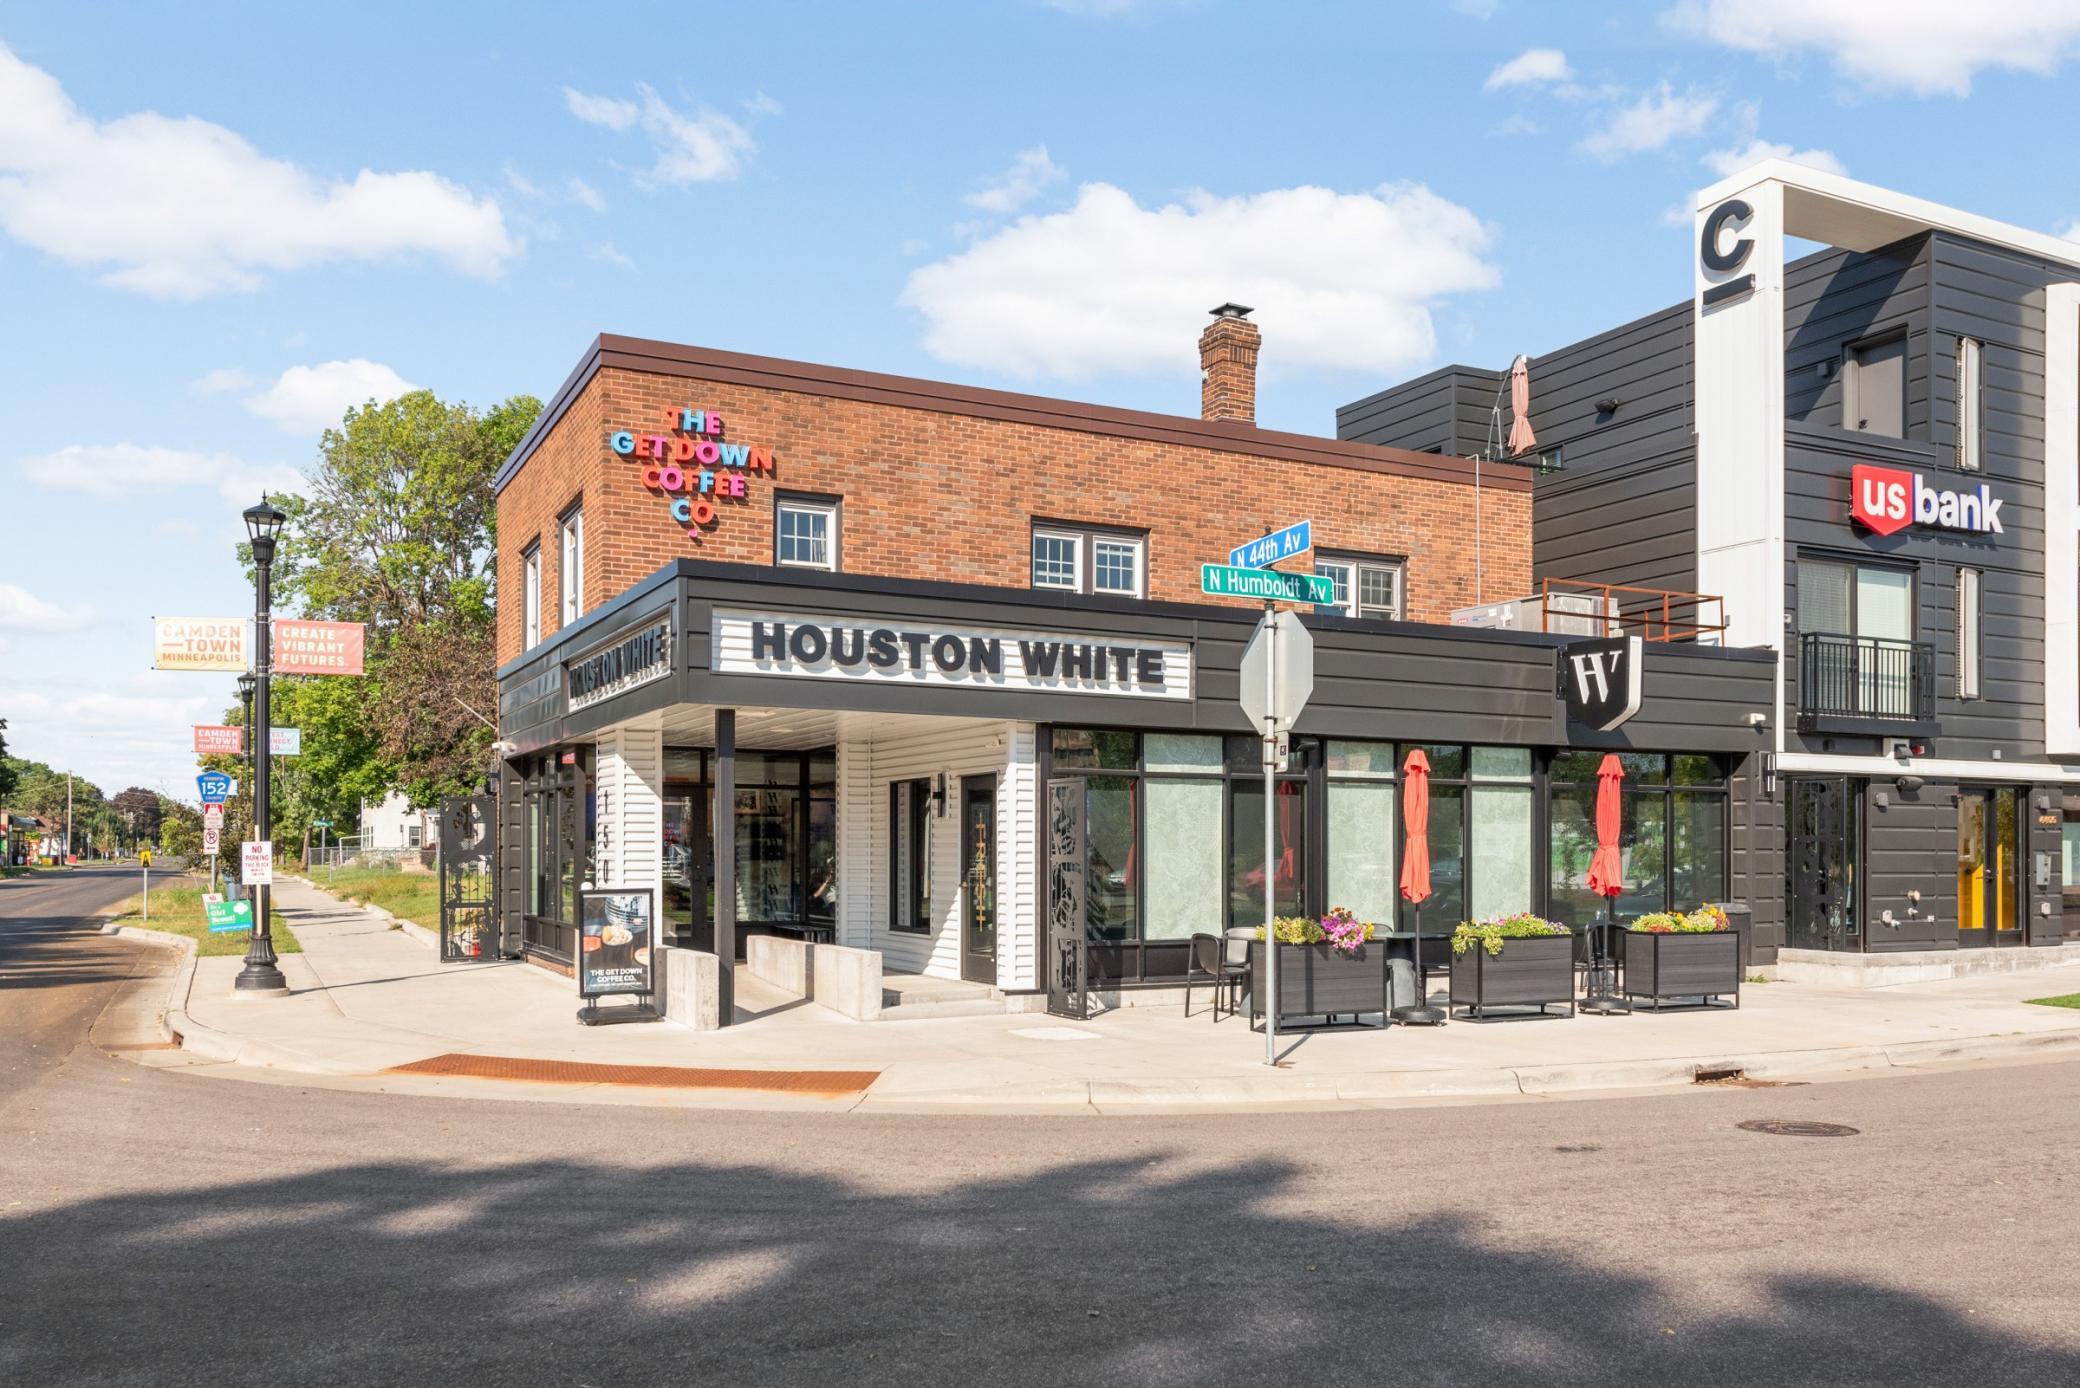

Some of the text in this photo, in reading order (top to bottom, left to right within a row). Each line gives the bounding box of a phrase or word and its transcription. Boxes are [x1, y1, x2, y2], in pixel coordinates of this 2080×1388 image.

[1701, 199, 1755, 271] C
[666, 405, 721, 434] THE
[611, 431, 774, 470] GET DOWN
[642, 465, 745, 497] COFFEE
[1863, 474, 2004, 533] us bank
[1236, 532, 1301, 568] N 44th Av
[1209, 568, 1327, 601] N Humboldt Av
[162, 624, 241, 639] CAMDEN
[281, 627, 336, 640] CREATE
[162, 652, 241, 662] MINNEAPOLIS
[281, 653, 349, 666] FUTURES.
[282, 640, 345, 653] VIBRANT
[752, 621, 1165, 685] HOUSTON WHITE
[569, 625, 666, 699] HOUSTON WHITE
[198, 729, 238, 738] CAMDEN
[202, 782, 226, 795] 152
[605, 968, 619, 976] GET
[620, 967, 643, 975] DOWN
